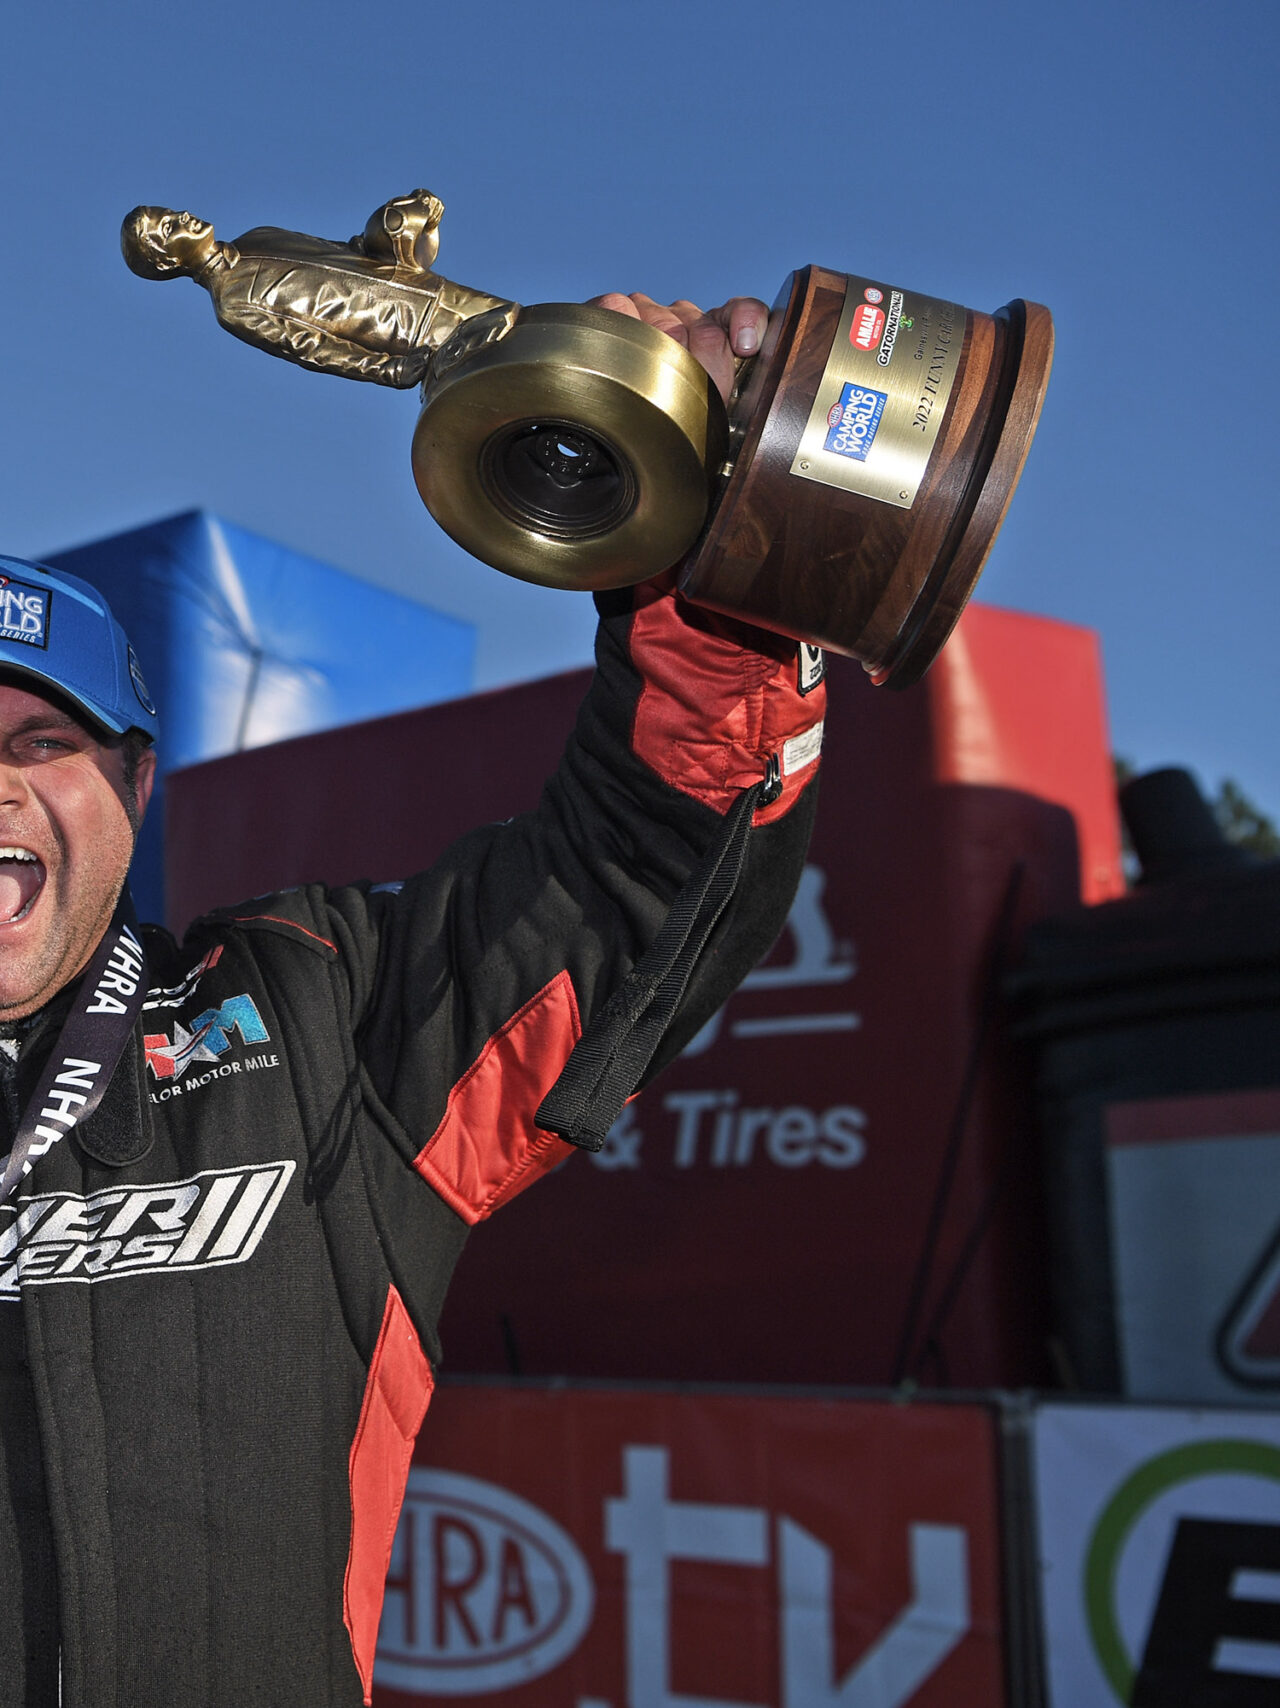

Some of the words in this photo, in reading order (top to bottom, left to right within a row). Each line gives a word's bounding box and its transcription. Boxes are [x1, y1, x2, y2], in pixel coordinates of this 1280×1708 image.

[856, 306, 878, 347] AMALIE
[913, 397, 933, 432] 2022
[925, 345, 949, 395] FUNNY
[833, 389, 864, 451] CAMPING
[844, 393, 877, 453] WORLD
[186, 1061, 242, 1091] MOTOR
[245, 1054, 280, 1071] MILE
[664, 1088, 867, 1169] Tires
[381, 1508, 541, 1650] HRA
